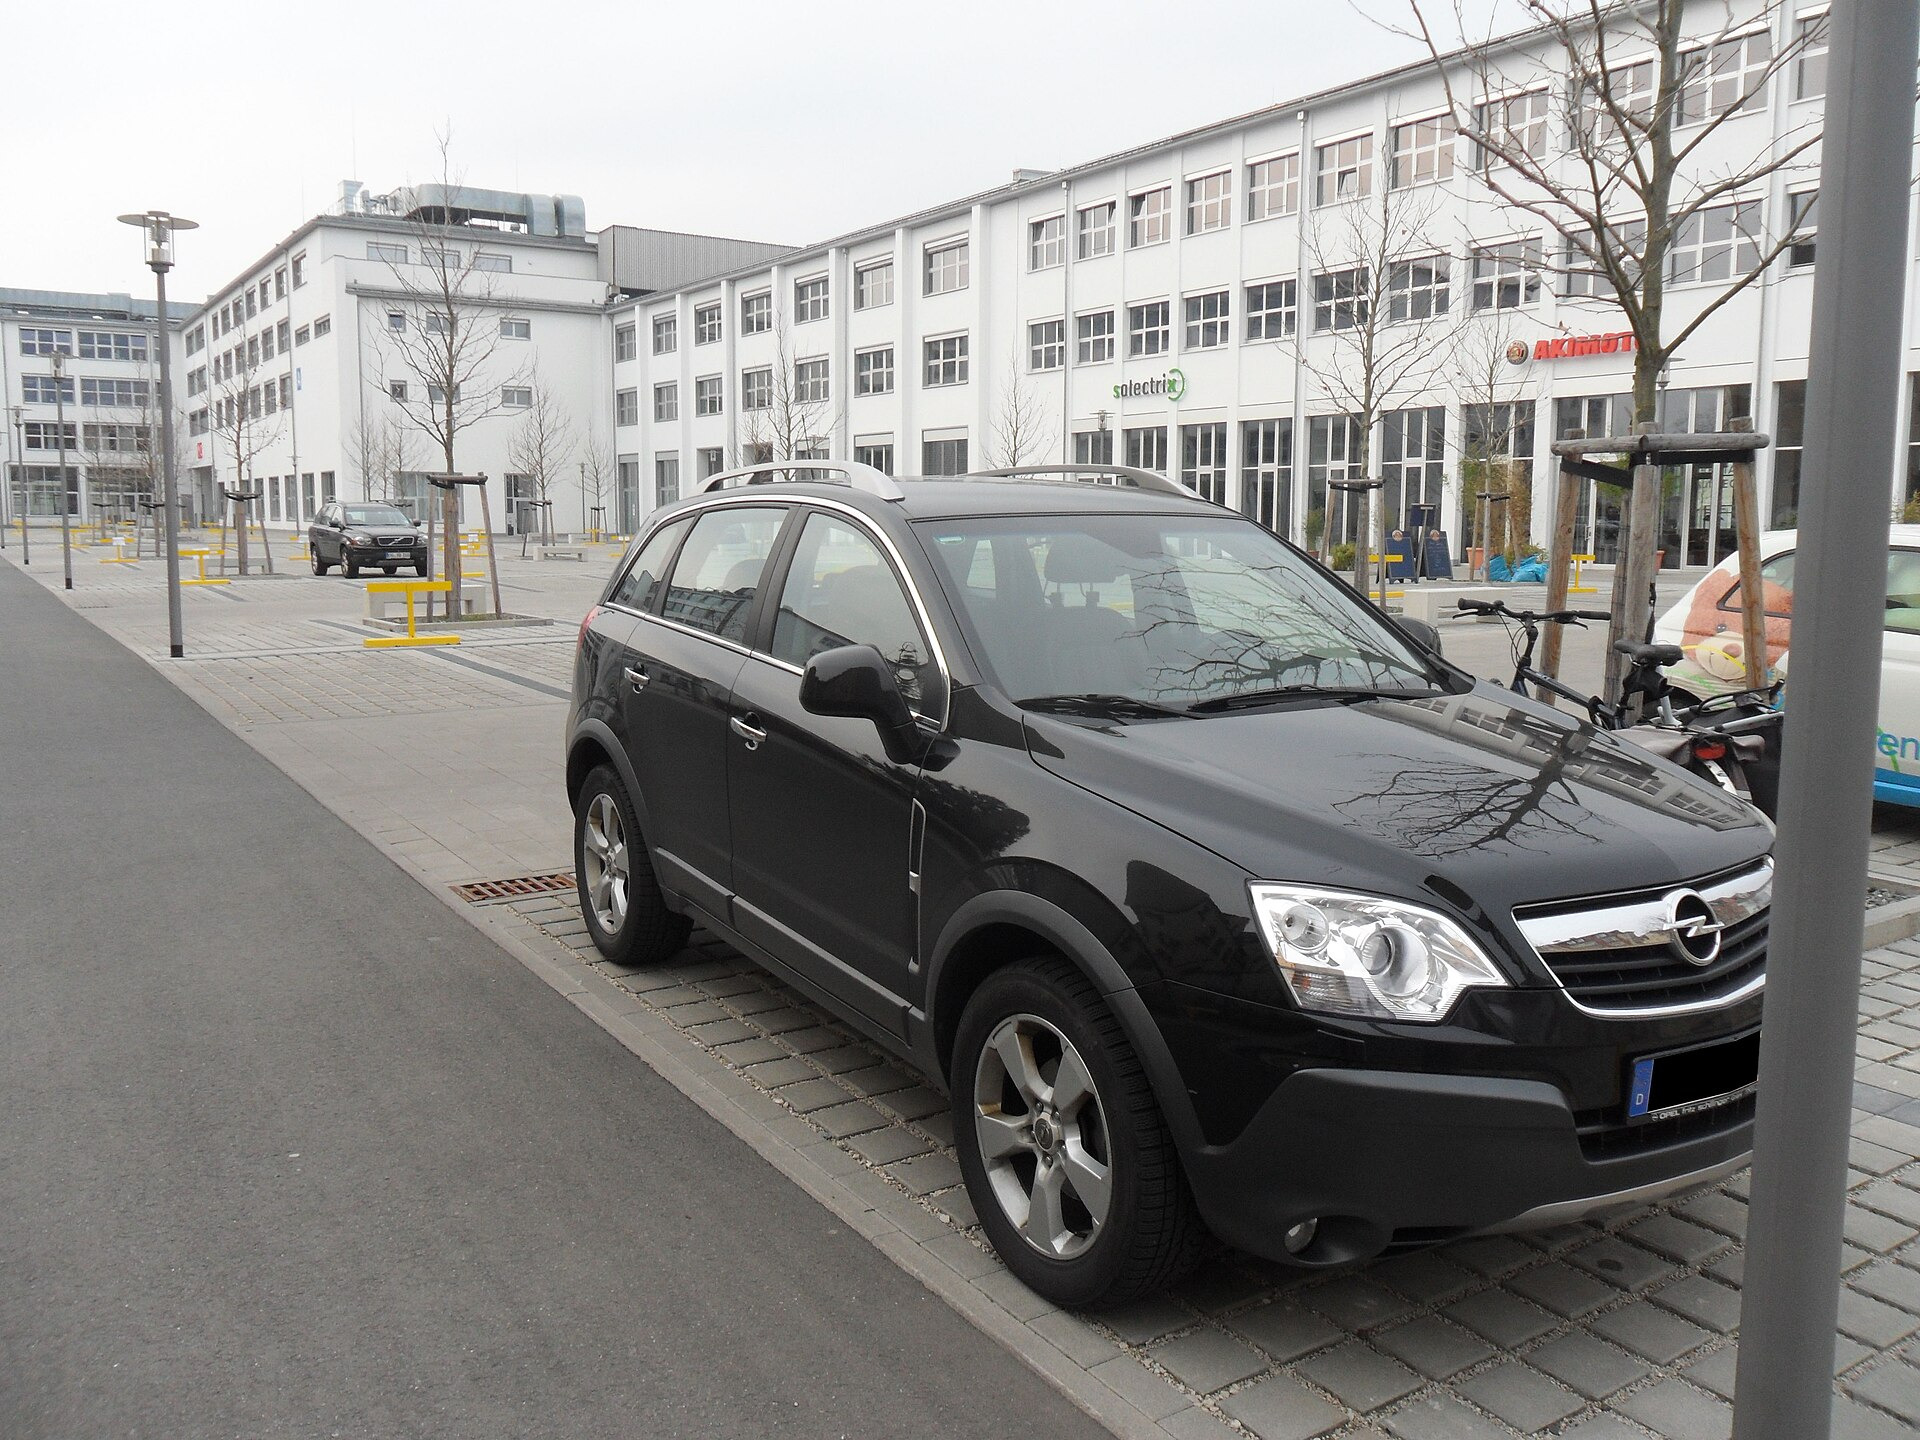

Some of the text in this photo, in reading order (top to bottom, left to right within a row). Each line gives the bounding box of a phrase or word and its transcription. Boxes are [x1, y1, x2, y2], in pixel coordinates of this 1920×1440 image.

[1533, 331, 1639, 360] AKIMOT
[1113, 370, 1182, 400] solectrix
[1635, 1093, 1644, 1106] D
[1659, 1109, 1680, 1120] OPEL
